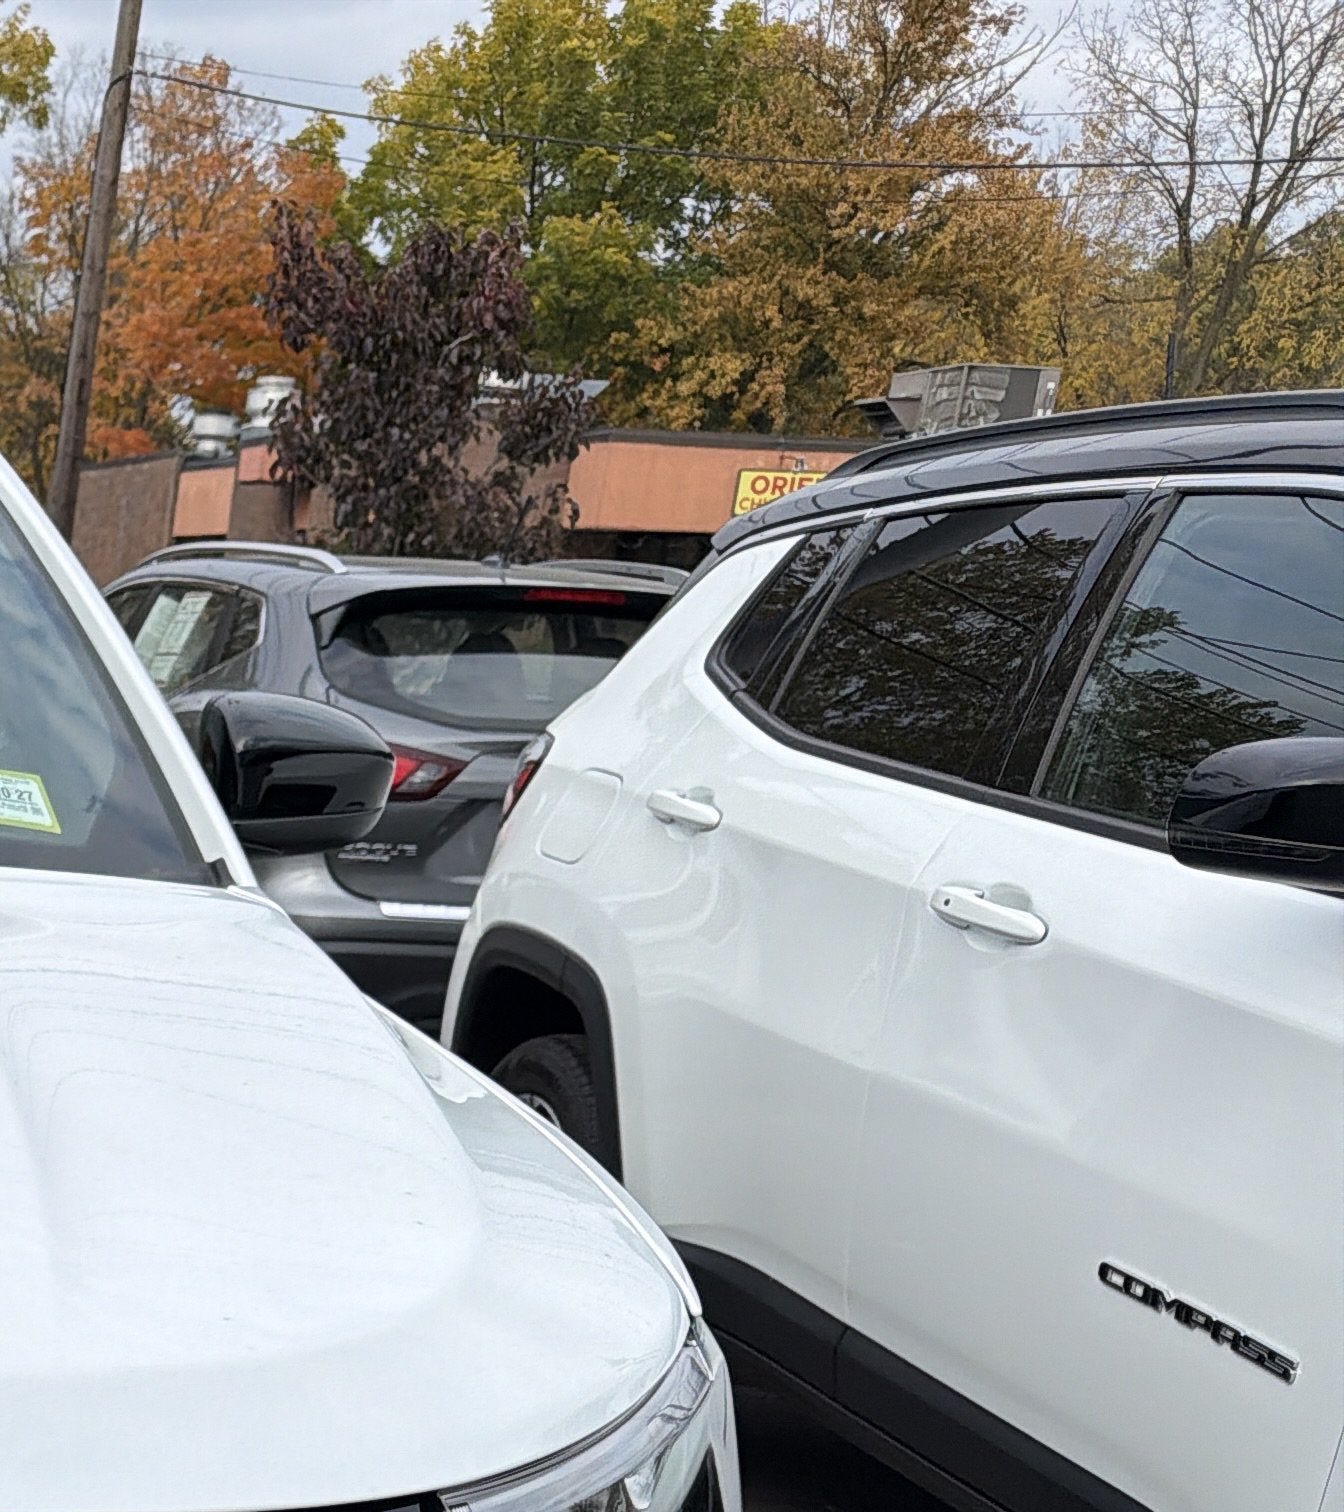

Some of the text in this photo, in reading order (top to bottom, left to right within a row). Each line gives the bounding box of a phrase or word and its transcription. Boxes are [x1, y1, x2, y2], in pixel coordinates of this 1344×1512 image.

[750, 474, 816, 496] ORIE
[14, 788, 33, 802] 27
[1097, 1260, 1301, 1385] COMPASS
